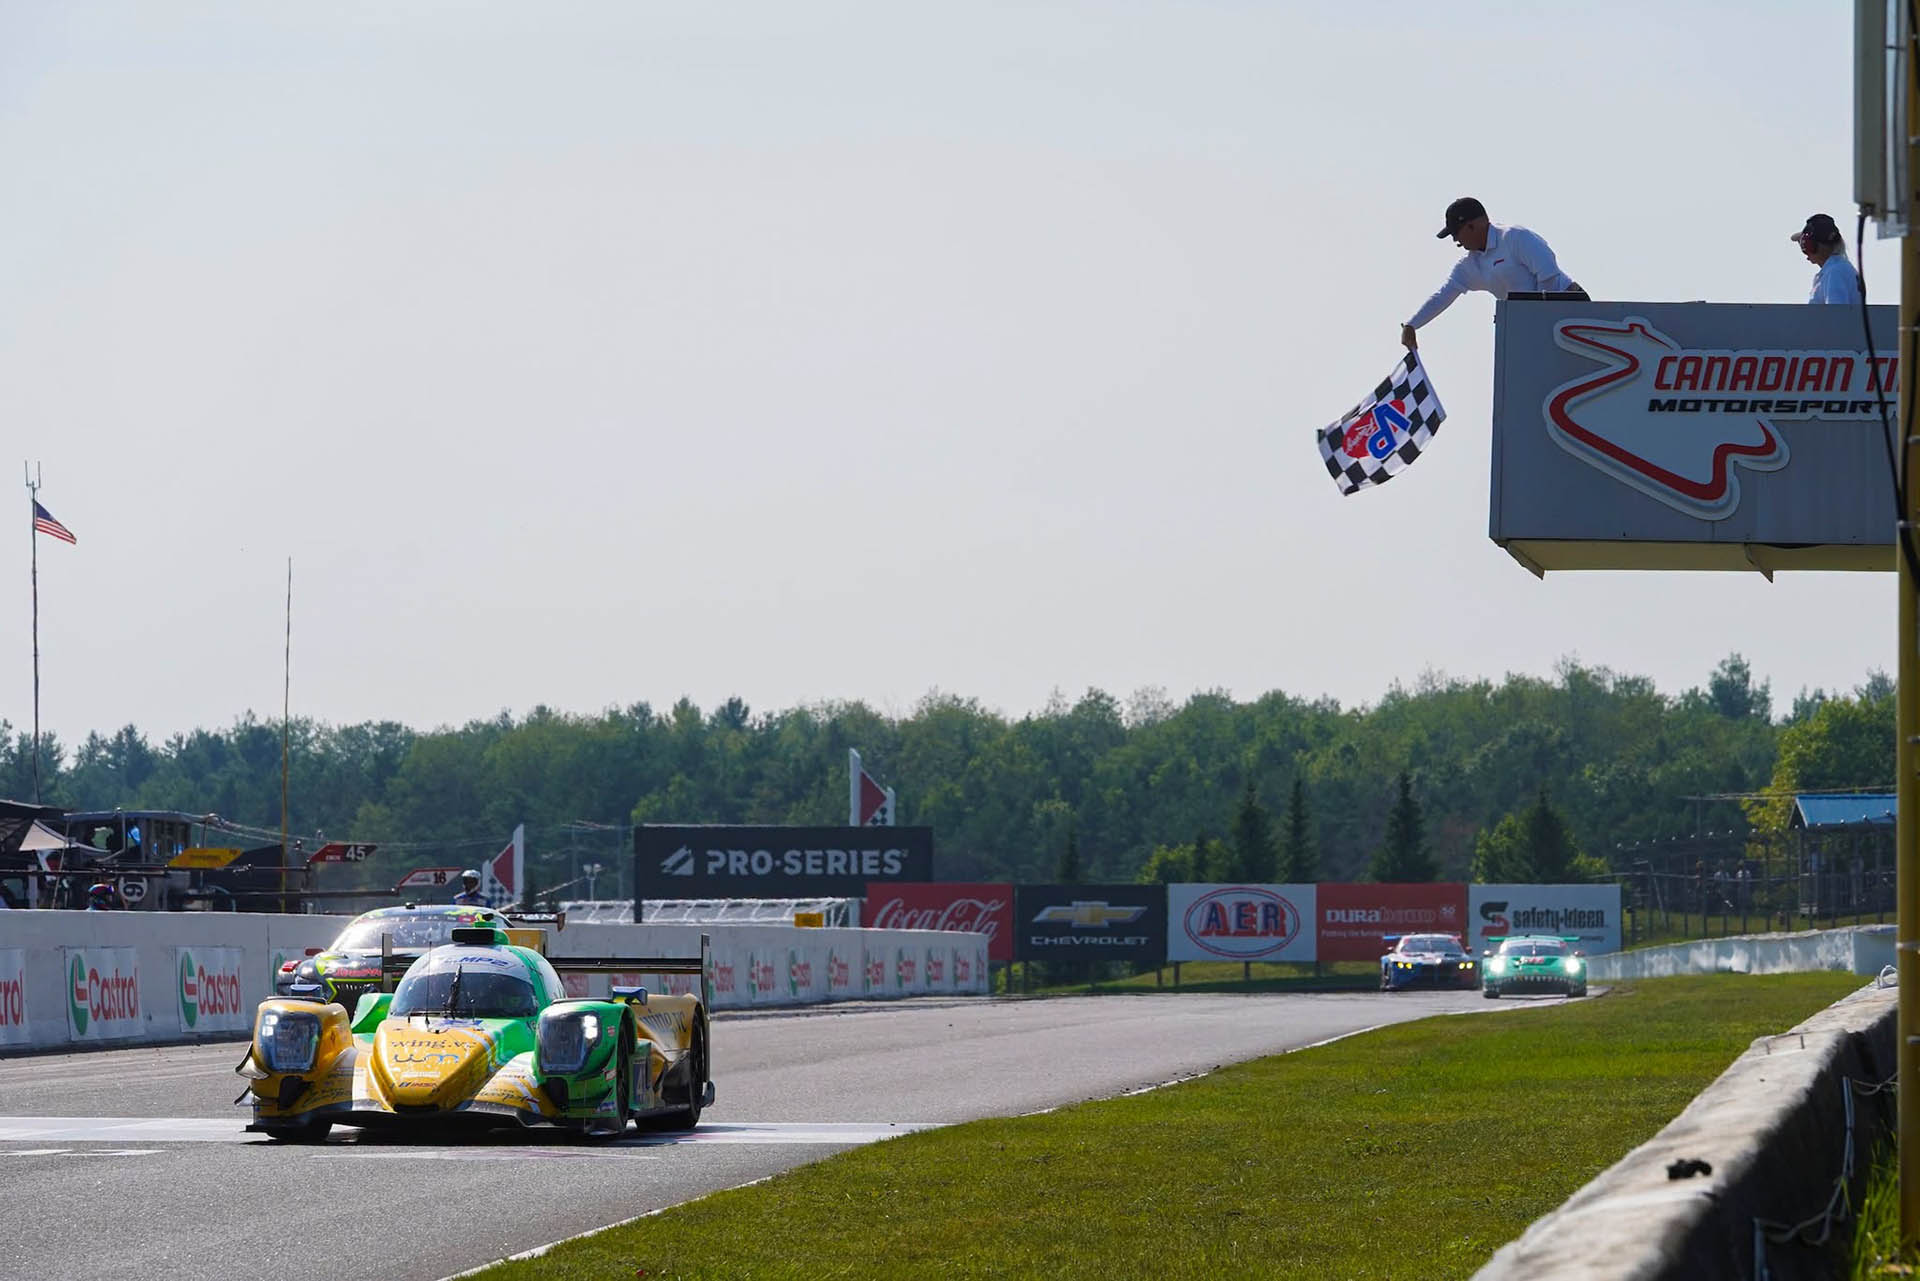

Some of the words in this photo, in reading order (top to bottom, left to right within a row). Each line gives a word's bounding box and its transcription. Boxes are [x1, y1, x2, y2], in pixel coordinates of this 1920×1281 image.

[1654, 356, 1854, 392] CANADIAN
[1866, 357, 1900, 392] TI
[346, 846, 366, 860] 45
[1198, 901, 1286, 937] AER
[1031, 936, 1149, 945] CHEVROLET
[88, 967, 139, 1021] Castrol
[198, 965, 241, 1015] Castrol
